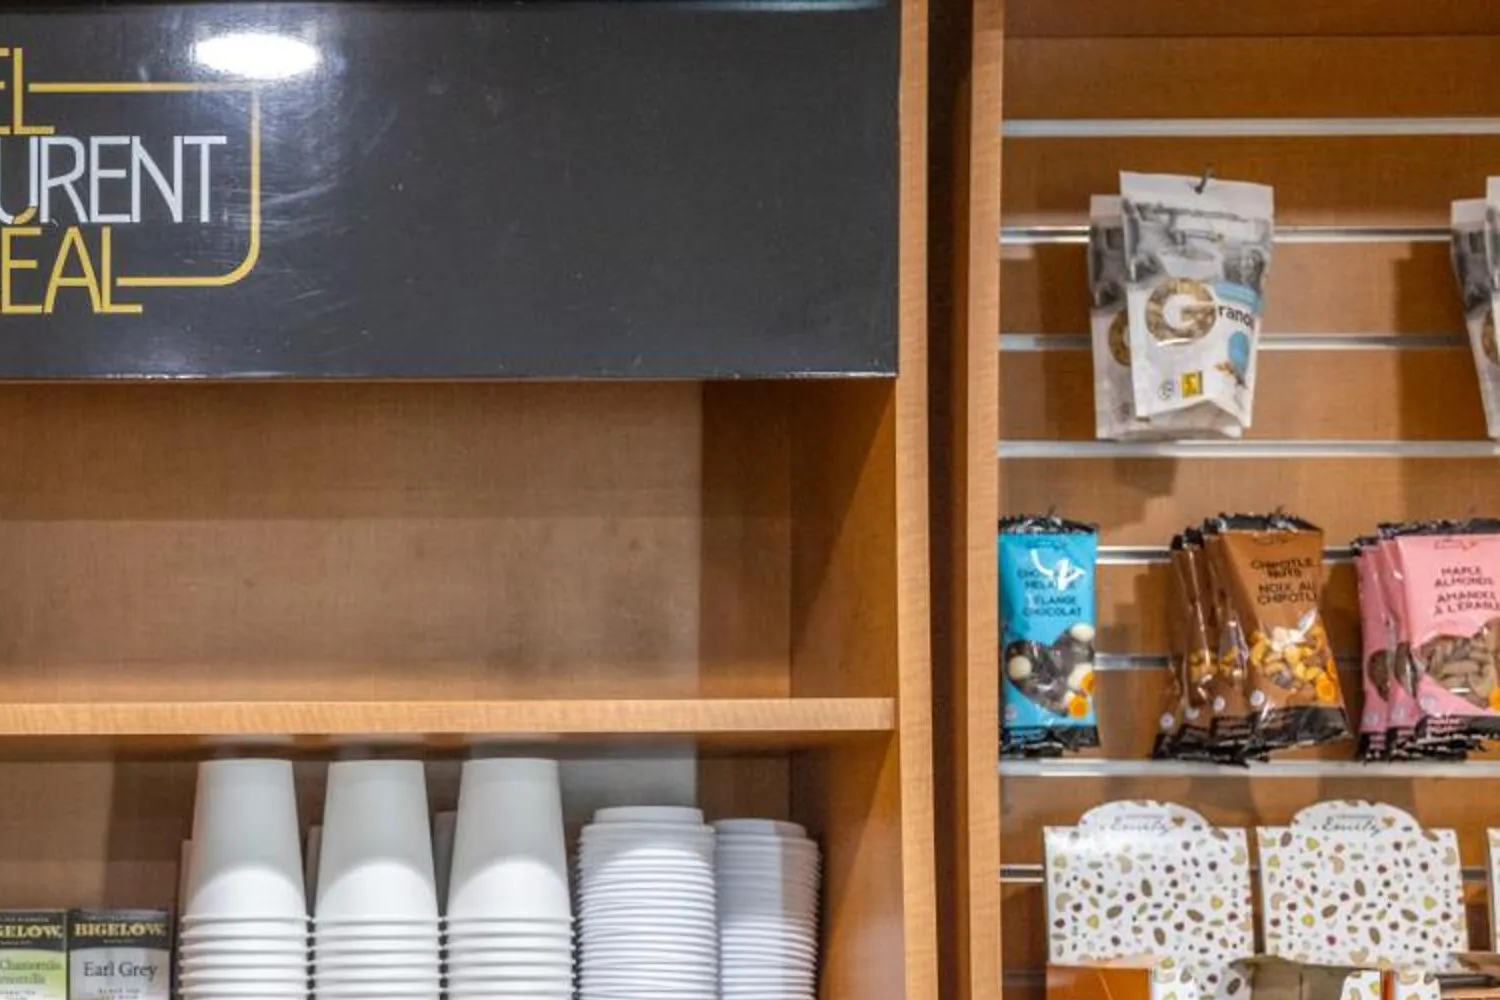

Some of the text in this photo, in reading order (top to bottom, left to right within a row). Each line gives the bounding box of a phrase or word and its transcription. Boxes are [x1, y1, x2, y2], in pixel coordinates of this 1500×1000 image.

[74, 923, 163, 937] BIGELOW
[83, 961, 159, 982] Earl Grey
